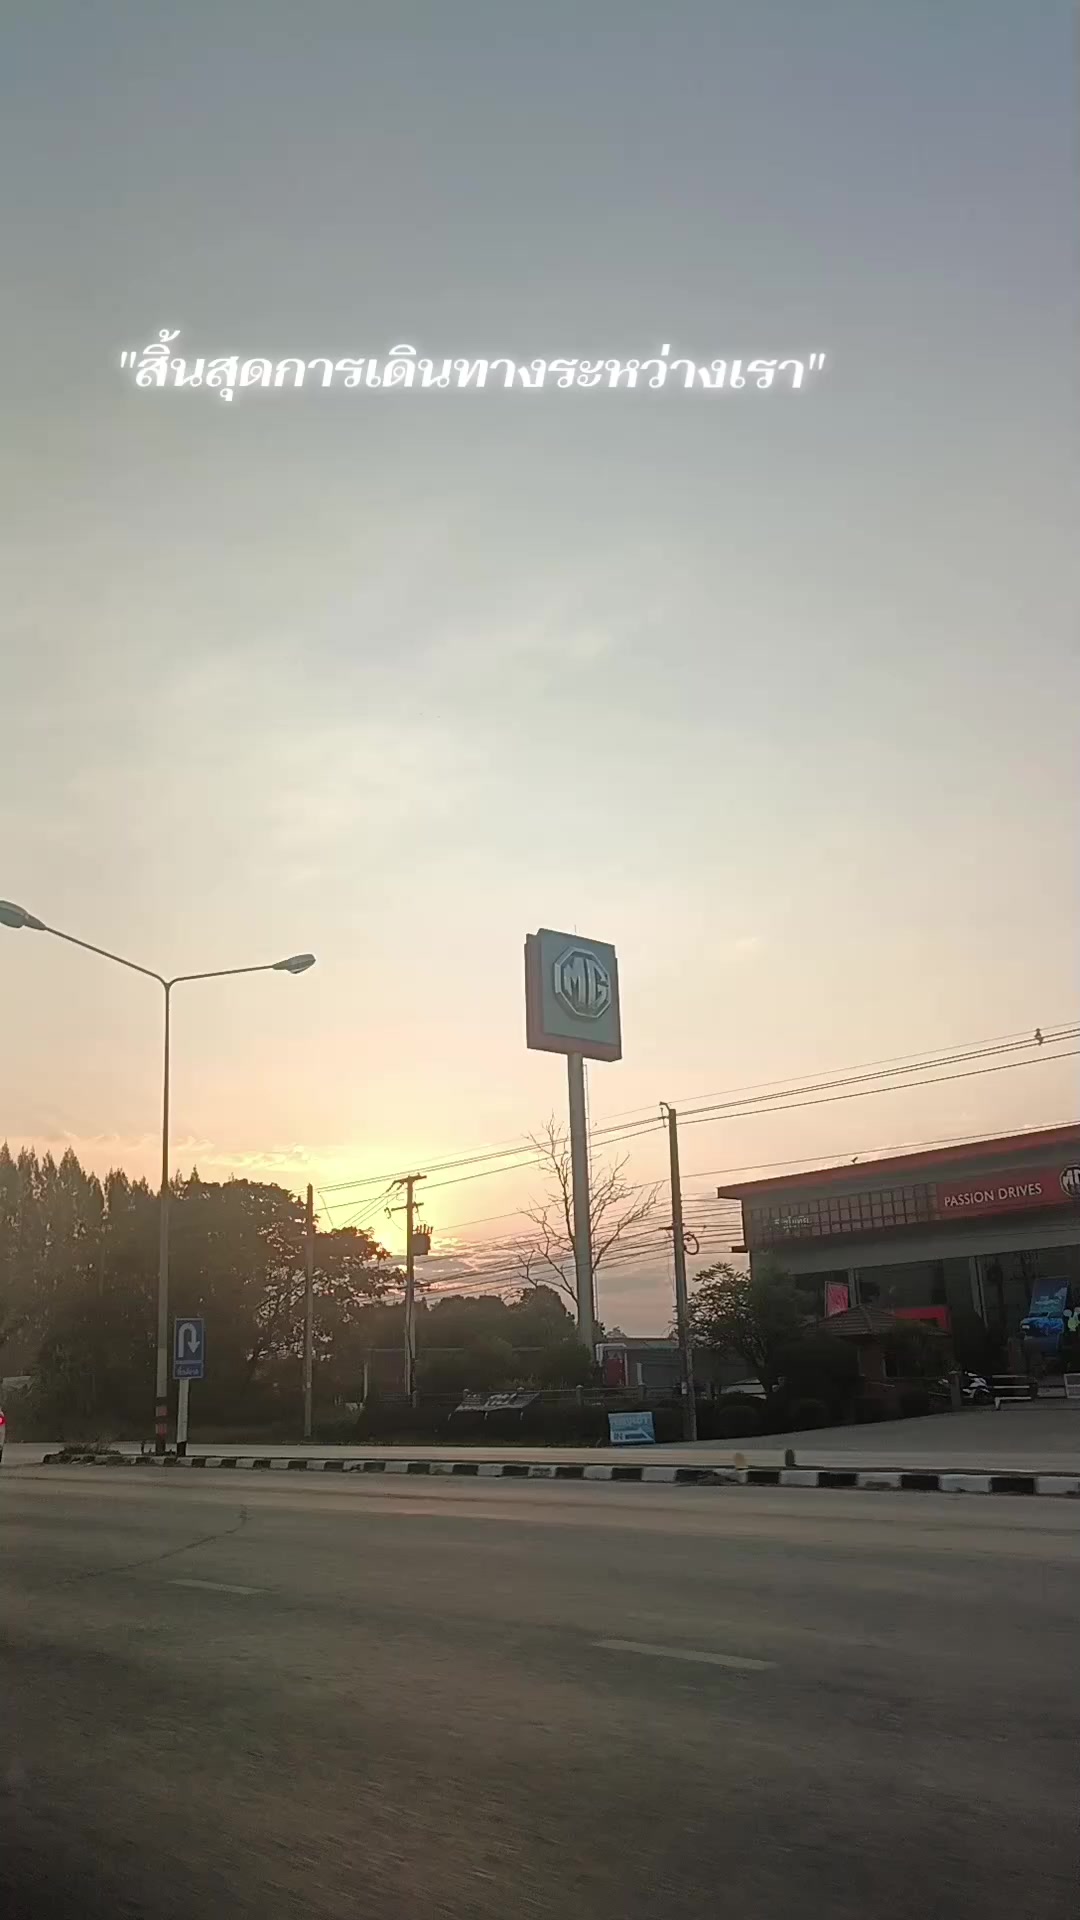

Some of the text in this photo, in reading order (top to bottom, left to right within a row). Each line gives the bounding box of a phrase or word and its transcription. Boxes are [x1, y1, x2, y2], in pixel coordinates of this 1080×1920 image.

[564, 957, 610, 1006] MG
[944, 1183, 1042, 1207] PASSION DRIVES
